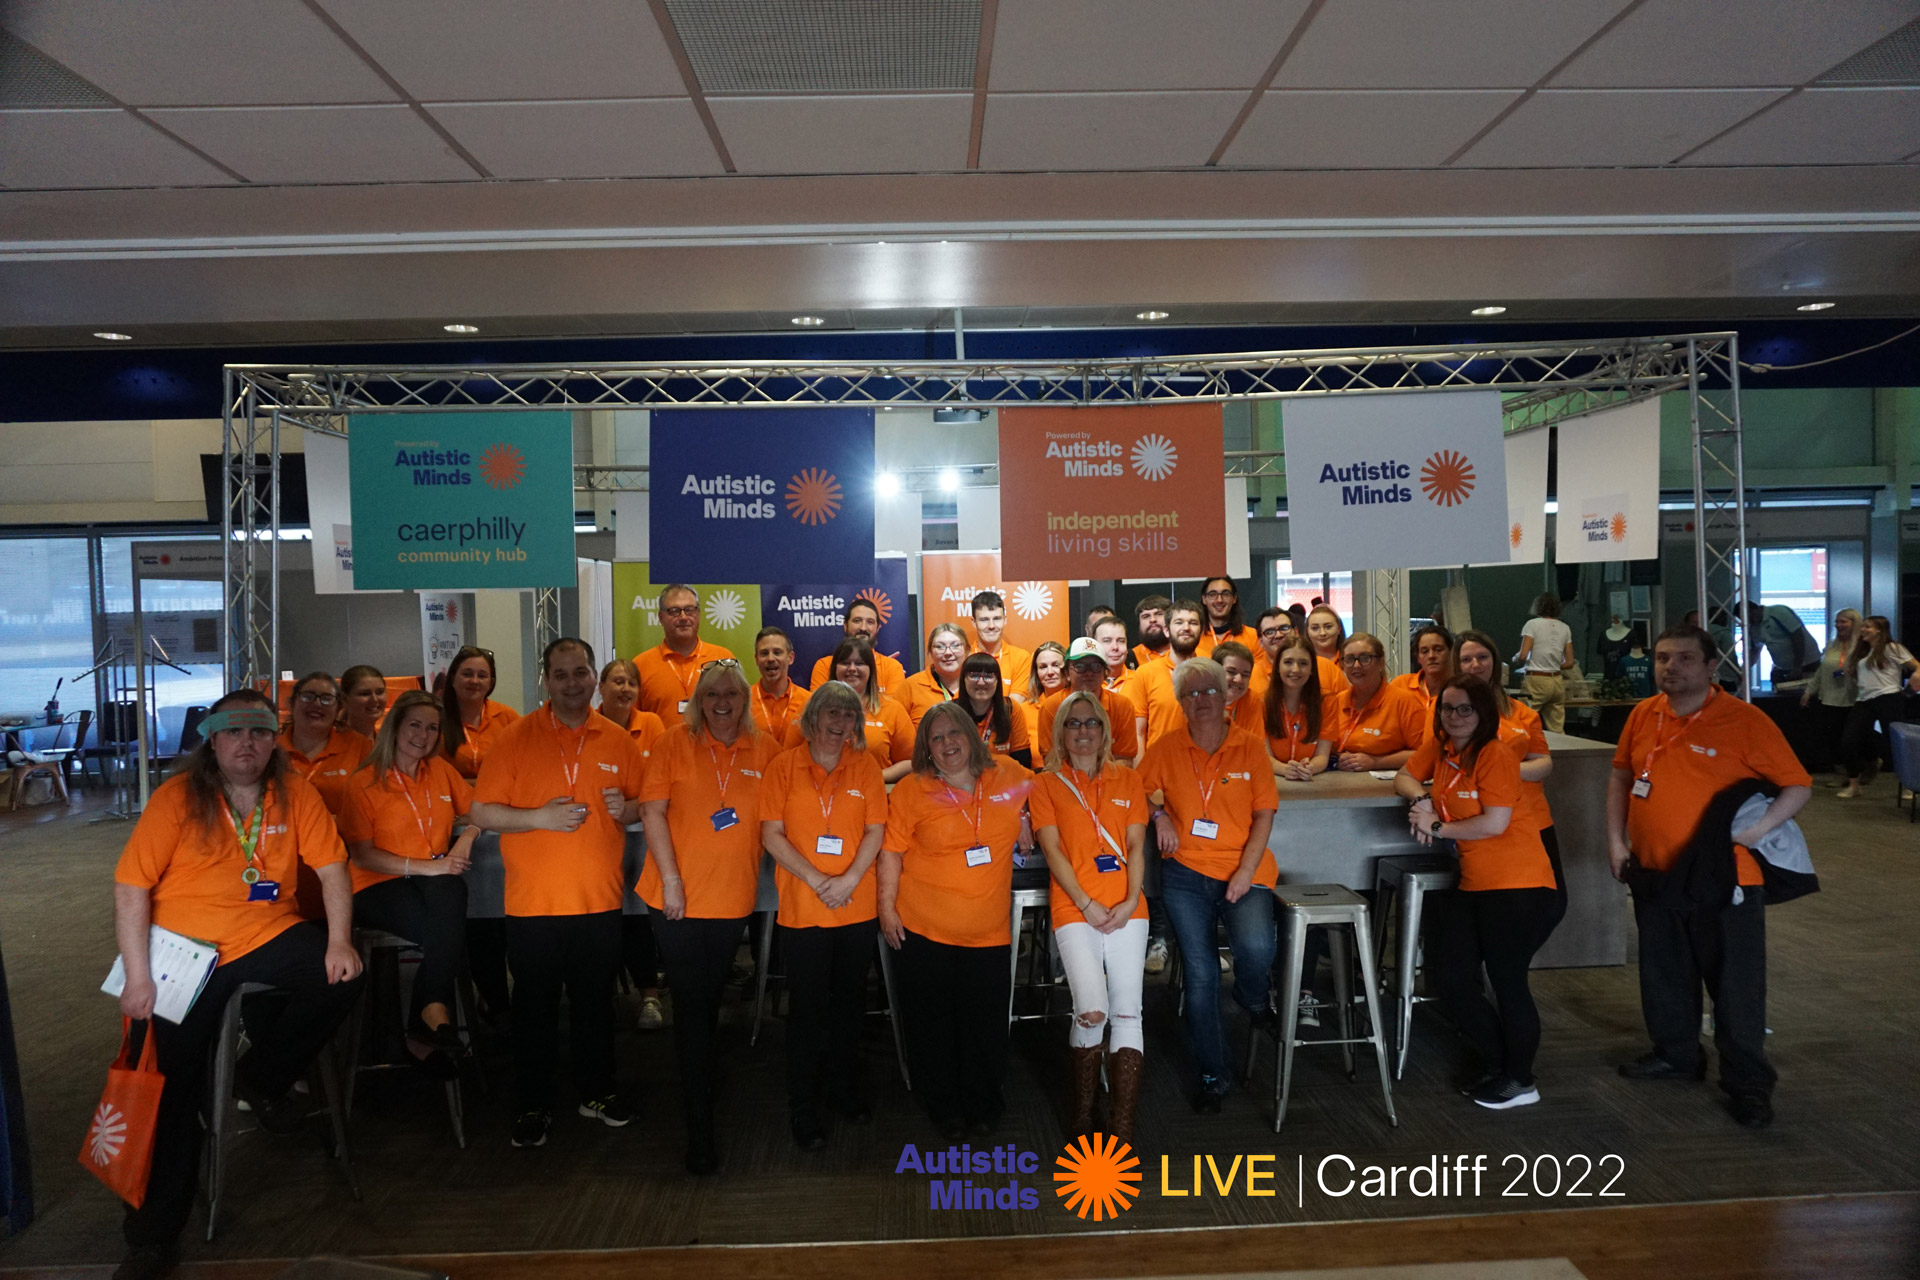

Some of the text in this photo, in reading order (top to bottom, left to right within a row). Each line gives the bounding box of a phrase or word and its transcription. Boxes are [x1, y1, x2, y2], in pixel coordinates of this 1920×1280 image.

[1082, 432, 1091, 440] by
[394, 449, 471, 466] Autistic
[1045, 440, 1123, 458] Autistic
[413, 469, 472, 485] Minds
[1064, 460, 1124, 477] Minds
[1319, 460, 1411, 483] Autistic
[681, 474, 776, 495] Autistic
[1342, 483, 1412, 506] Minds
[703, 498, 776, 519] Minds
[1047, 509, 1179, 534] independent
[1582, 518, 1608, 530] Autistic
[398, 516, 526, 546] caerphilly
[1588, 530, 1608, 542] Minds
[1048, 532, 1178, 557] living skills
[398, 547, 527, 565] community hub
[777, 594, 845, 611] Autistic
[793, 611, 845, 627] Minds
